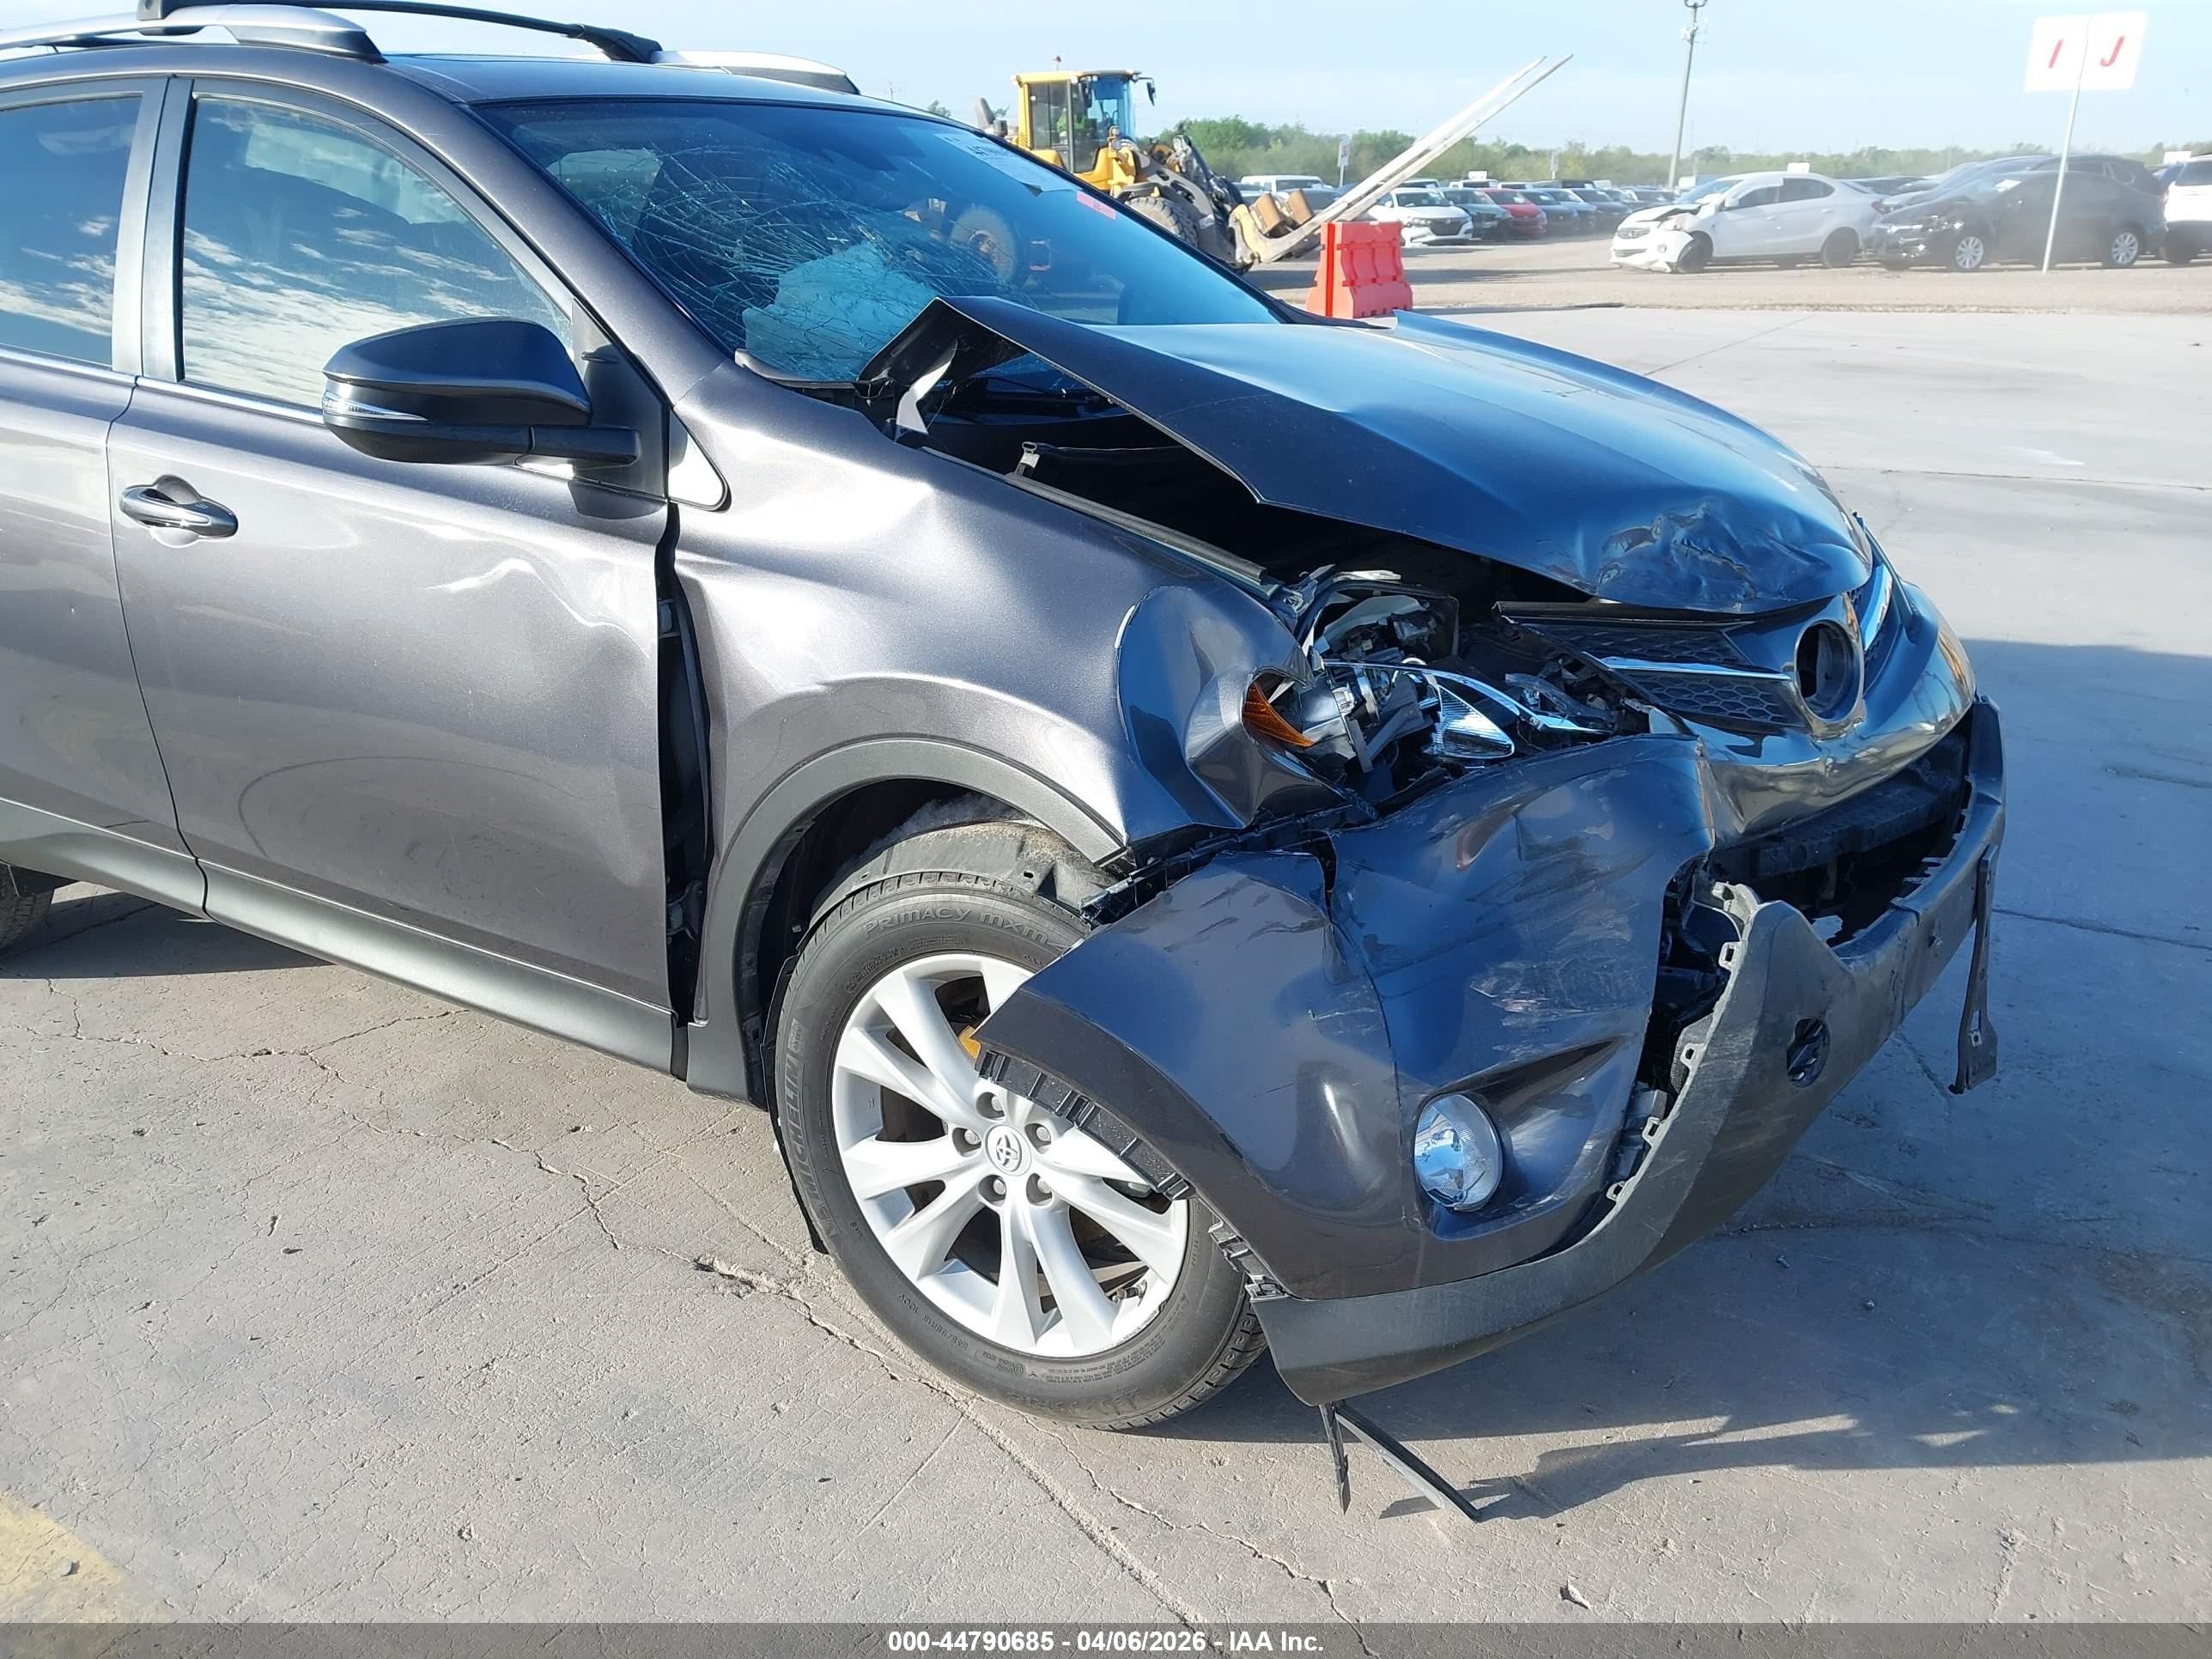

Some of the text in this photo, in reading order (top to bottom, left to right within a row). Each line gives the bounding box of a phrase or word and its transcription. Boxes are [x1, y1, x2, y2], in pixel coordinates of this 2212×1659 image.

[2100, 35, 2125, 67] J
[864, 906, 972, 938] PRIMACY
[784, 1053, 842, 1237] MICHELIN
